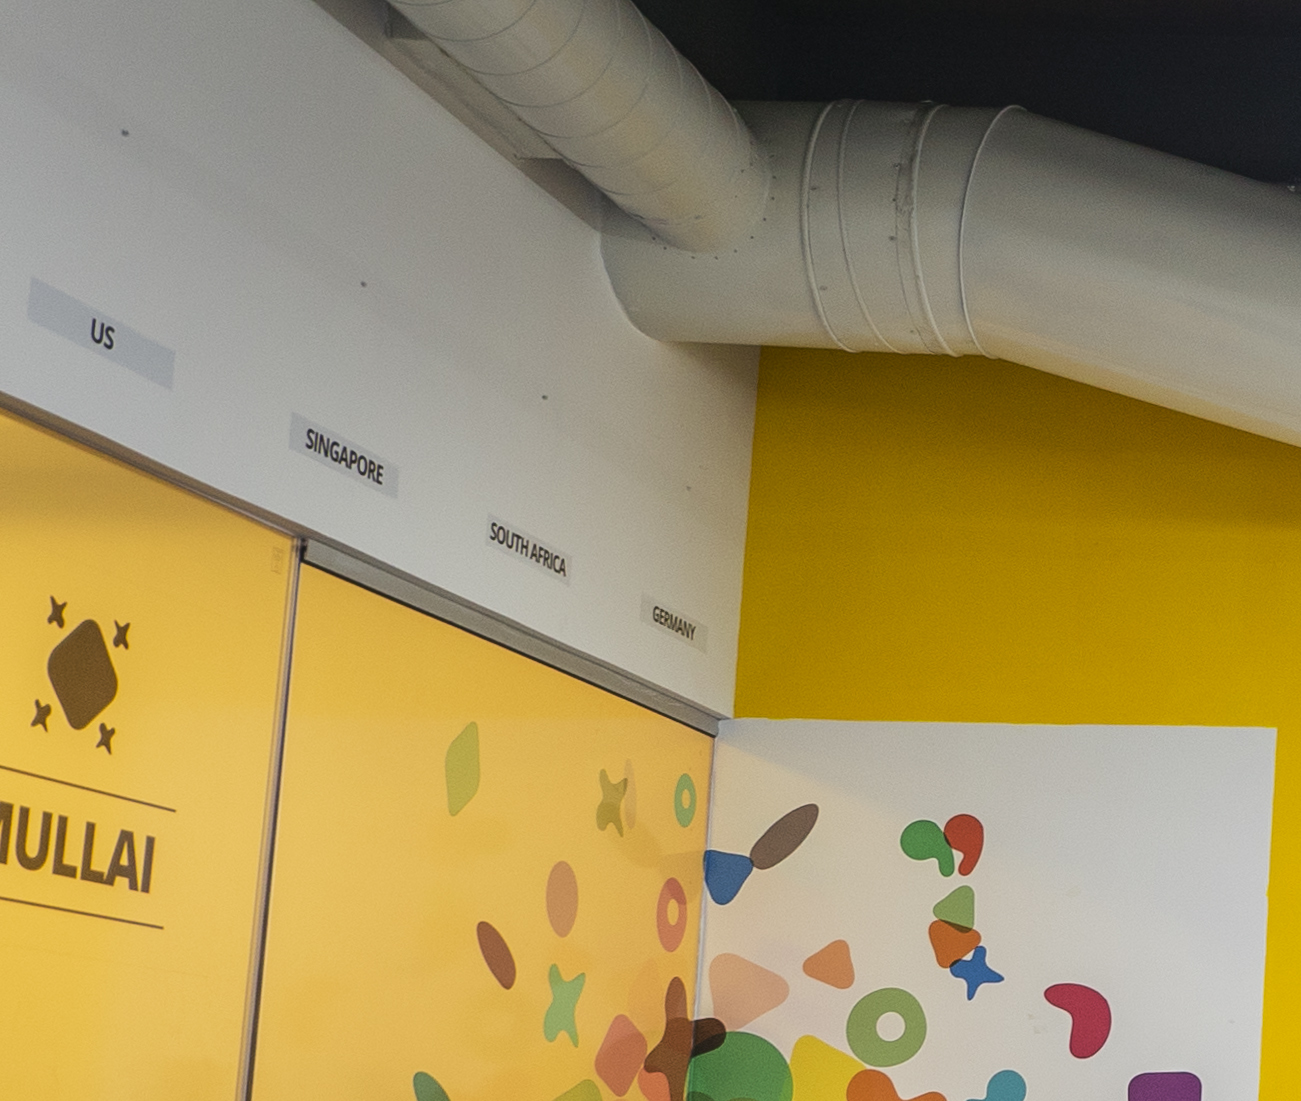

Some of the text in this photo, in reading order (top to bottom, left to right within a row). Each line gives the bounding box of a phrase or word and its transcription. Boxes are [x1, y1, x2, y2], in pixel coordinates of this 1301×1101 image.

[90, 318, 116, 351] US
[304, 427, 385, 487] SINGAPORE
[489, 521, 568, 578] SOUTH AFRICA
[652, 604, 697, 641] GERMANY
